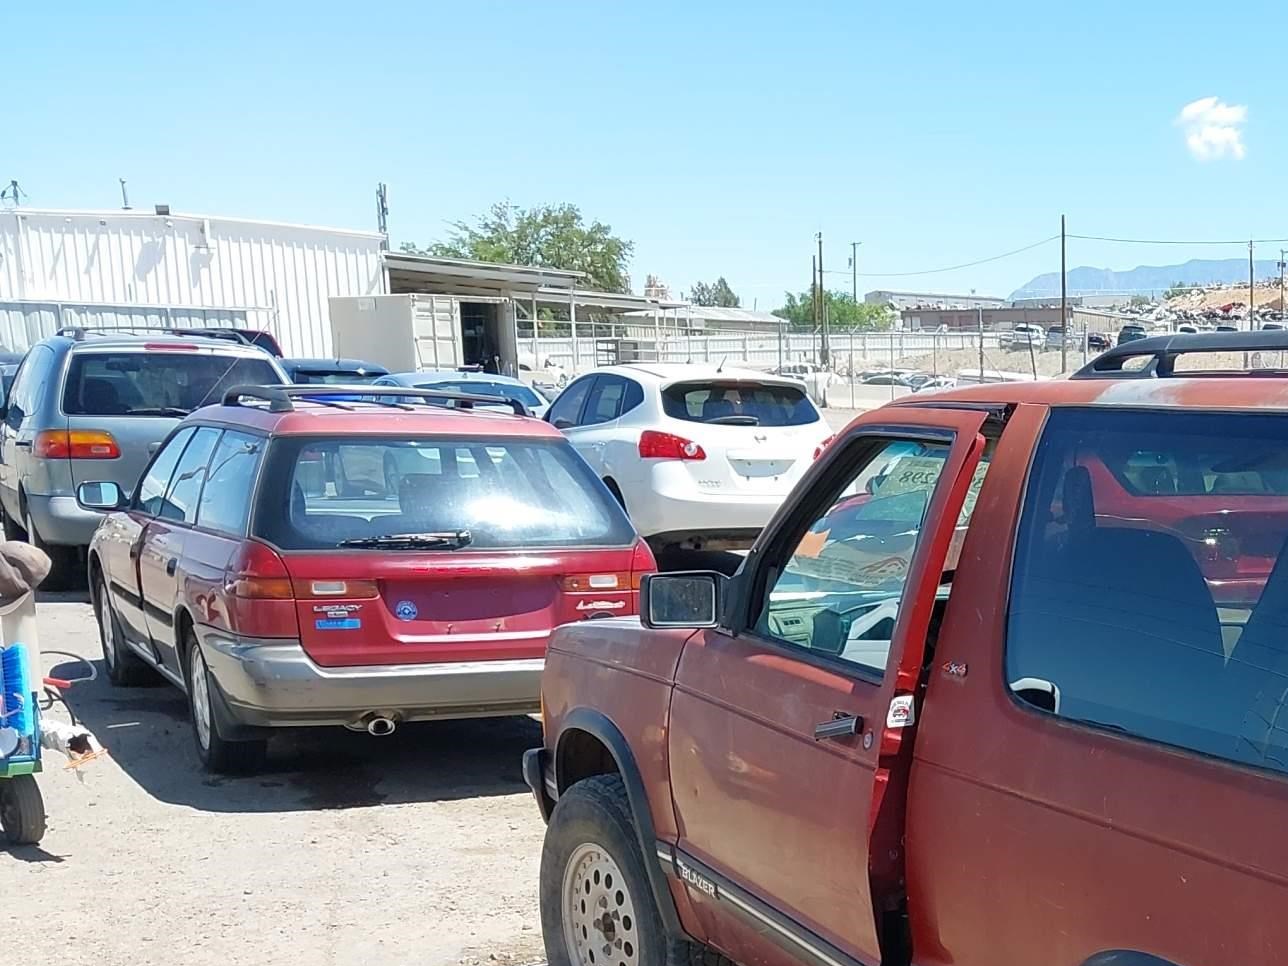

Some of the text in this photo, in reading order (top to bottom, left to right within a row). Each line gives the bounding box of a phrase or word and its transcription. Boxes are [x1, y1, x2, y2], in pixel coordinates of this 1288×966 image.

[313, 604, 363, 613] LEGACY
[942, 661, 967, 676] 4x4
[681, 867, 716, 898] BLAZER
